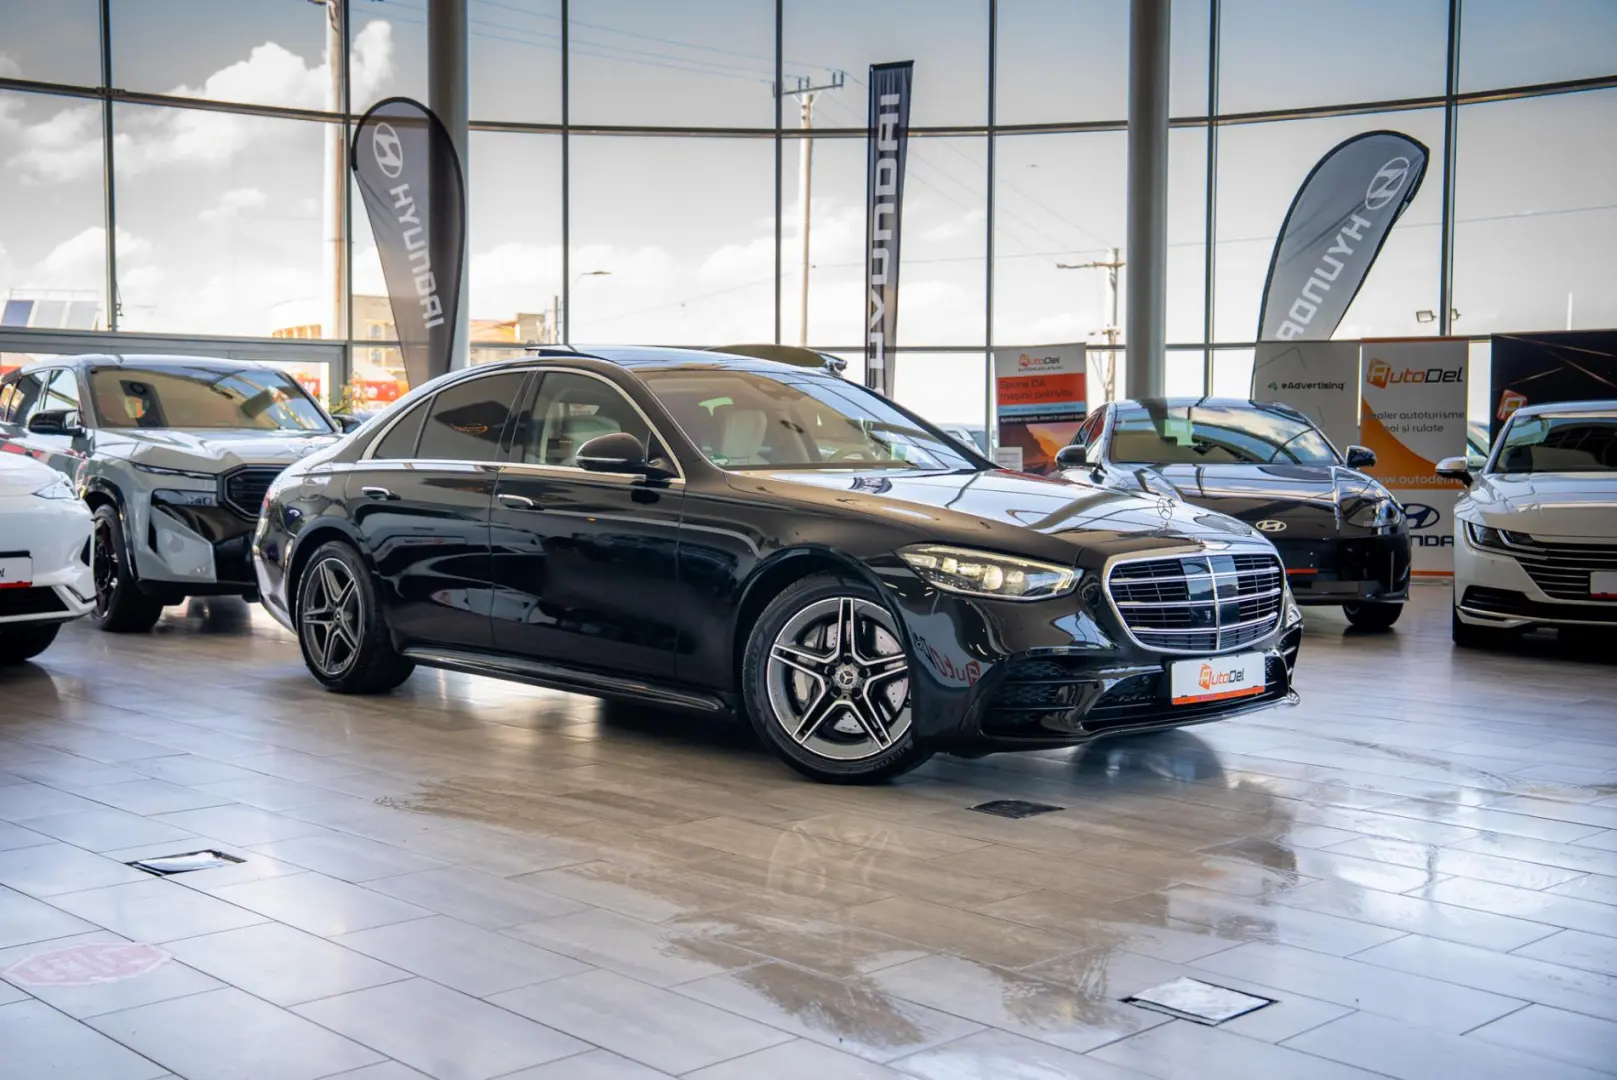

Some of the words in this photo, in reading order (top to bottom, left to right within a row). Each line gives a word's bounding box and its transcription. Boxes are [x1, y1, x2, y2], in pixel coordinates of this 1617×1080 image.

[869, 94, 899, 369] HYUNDAI
[390, 183, 444, 328] HYUNDAI
[1367, 359, 1463, 388] AutoDel
[1364, 411, 1397, 420] ealer
[1399, 410, 1465, 420] autoturisme
[1412, 423, 1444, 433] rulate
[1376, 474, 1464, 486] ww.autodel.ro
[1410, 535, 1454, 547] NDA
[1200, 665, 1244, 688] AutoDel
